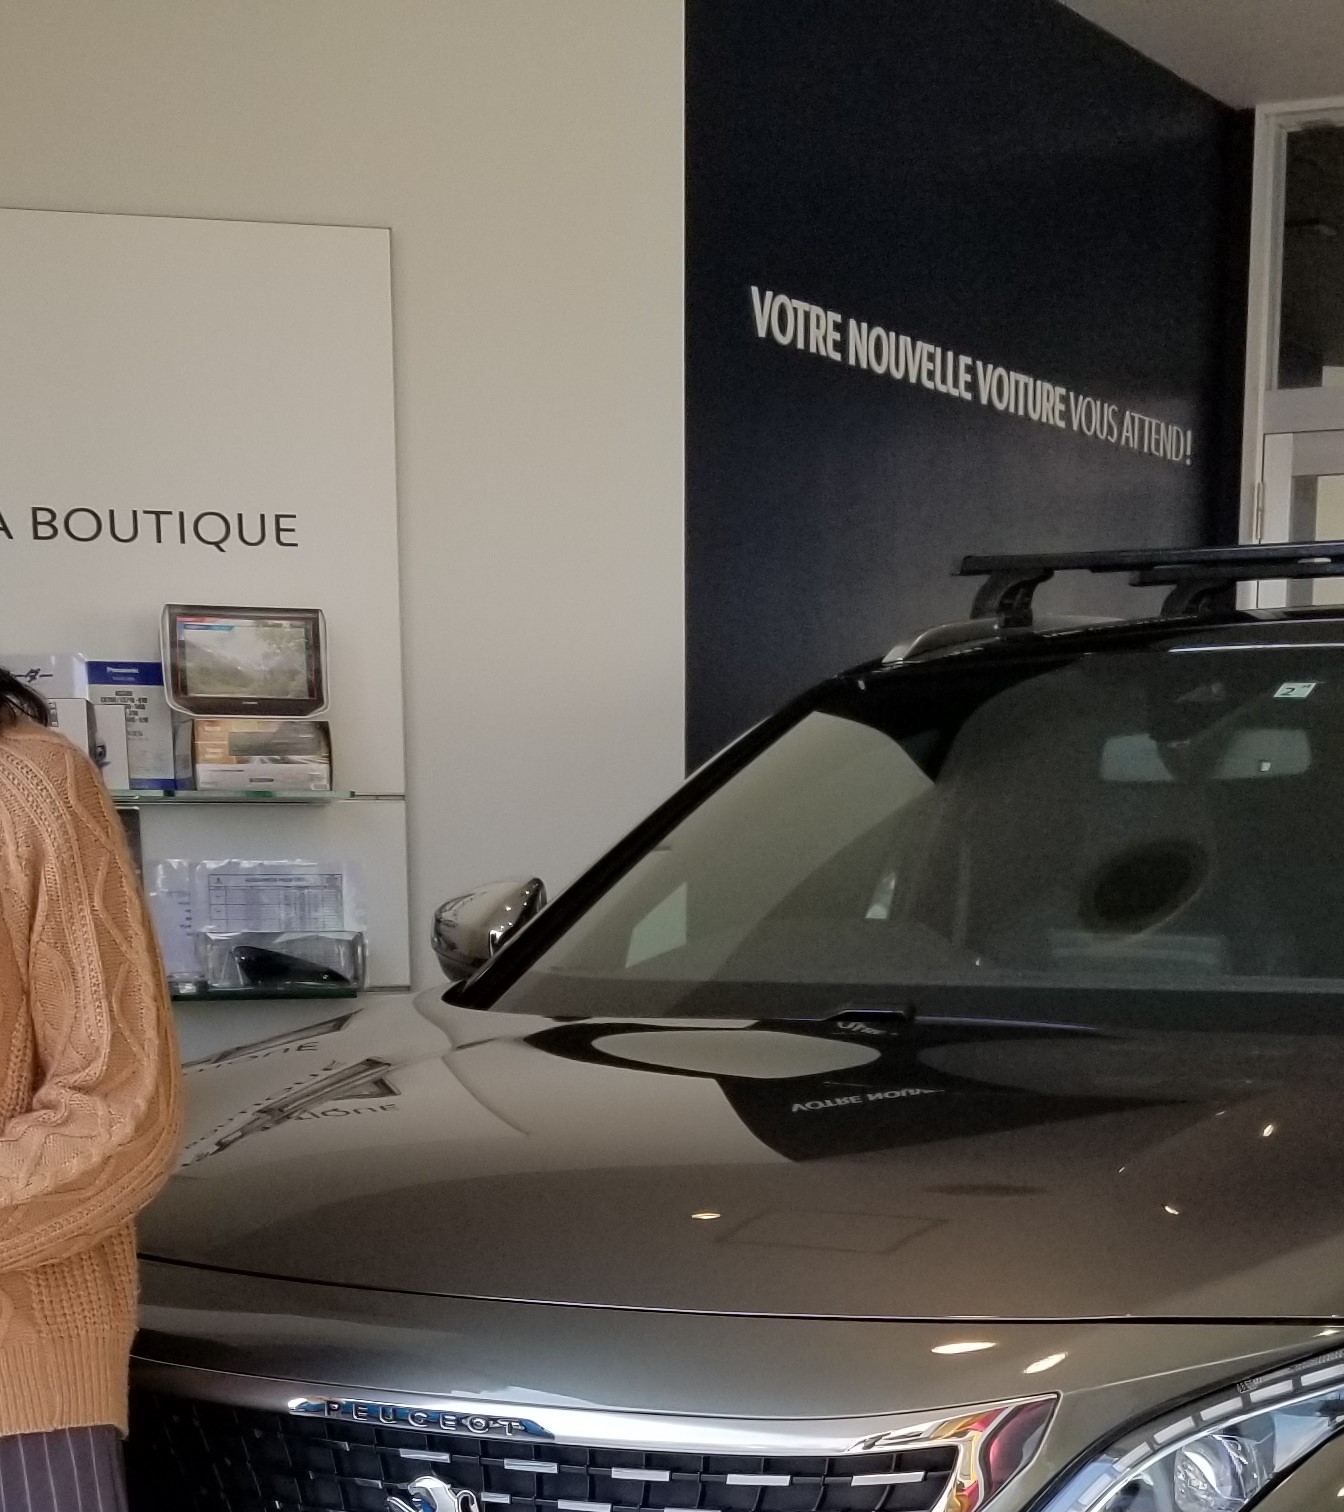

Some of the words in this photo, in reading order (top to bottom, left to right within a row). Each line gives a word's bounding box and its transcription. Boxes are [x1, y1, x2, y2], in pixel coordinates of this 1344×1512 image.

[751, 285, 841, 361] VOTRE
[848, 318, 972, 400] NOUVELLE
[976, 360, 1066, 428] VOITURE
[1069, 392, 1118, 443] VOUS
[1120, 410, 1193, 465] ATTEND!
[31, 506, 299, 553] BOUTIQUE
[324, 1401, 520, 1436] PEUGEOT
